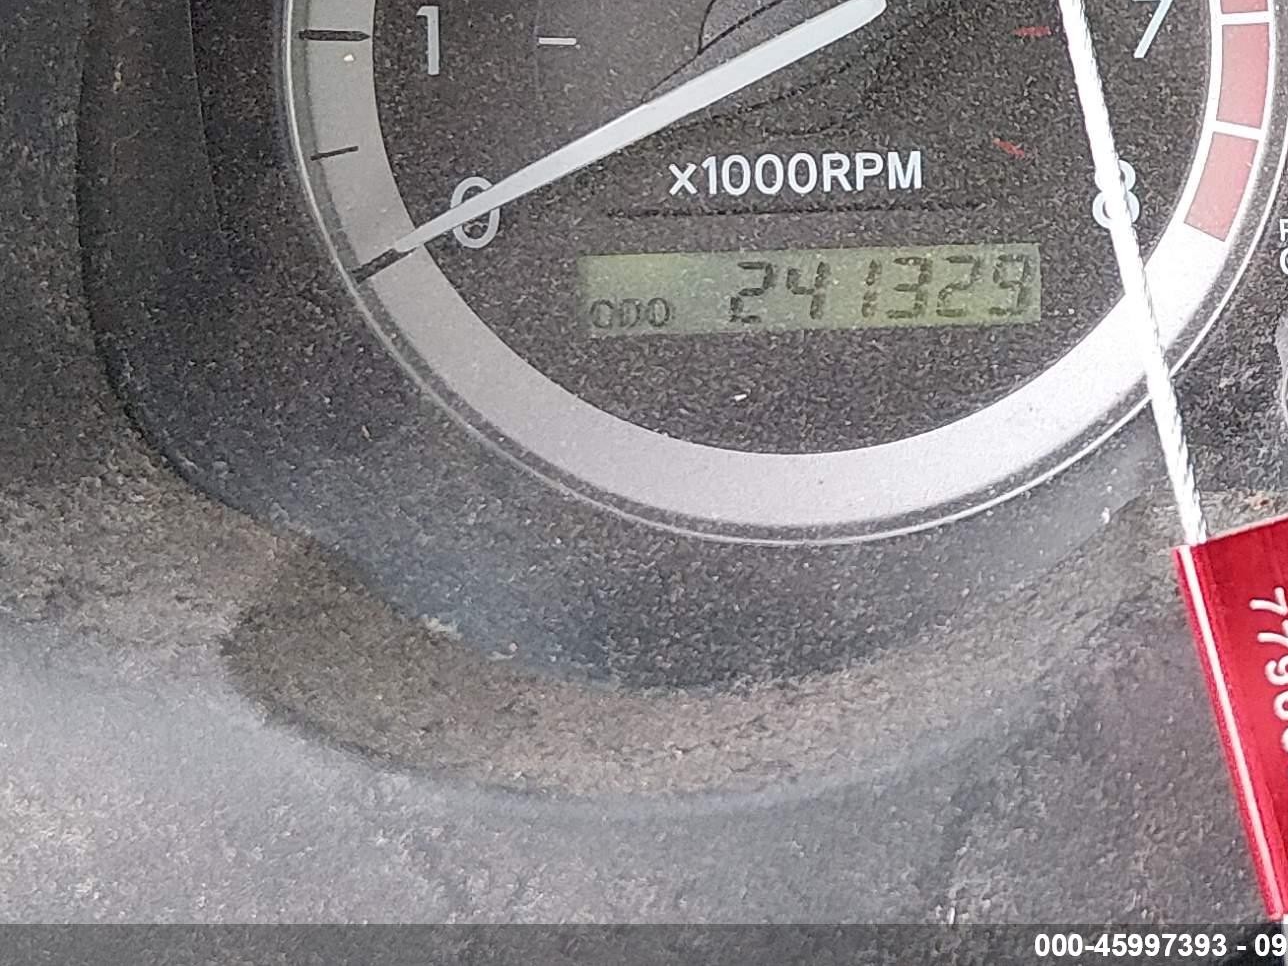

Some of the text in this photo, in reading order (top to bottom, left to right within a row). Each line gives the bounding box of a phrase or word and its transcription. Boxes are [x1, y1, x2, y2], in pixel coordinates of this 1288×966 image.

[414, 5, 441, 75] 1
[668, 150, 922, 196] x1000RPM
[450, 176, 500, 248] 0
[590, 297, 672, 328] ODO
[729, 254, 1036, 323] 241329
